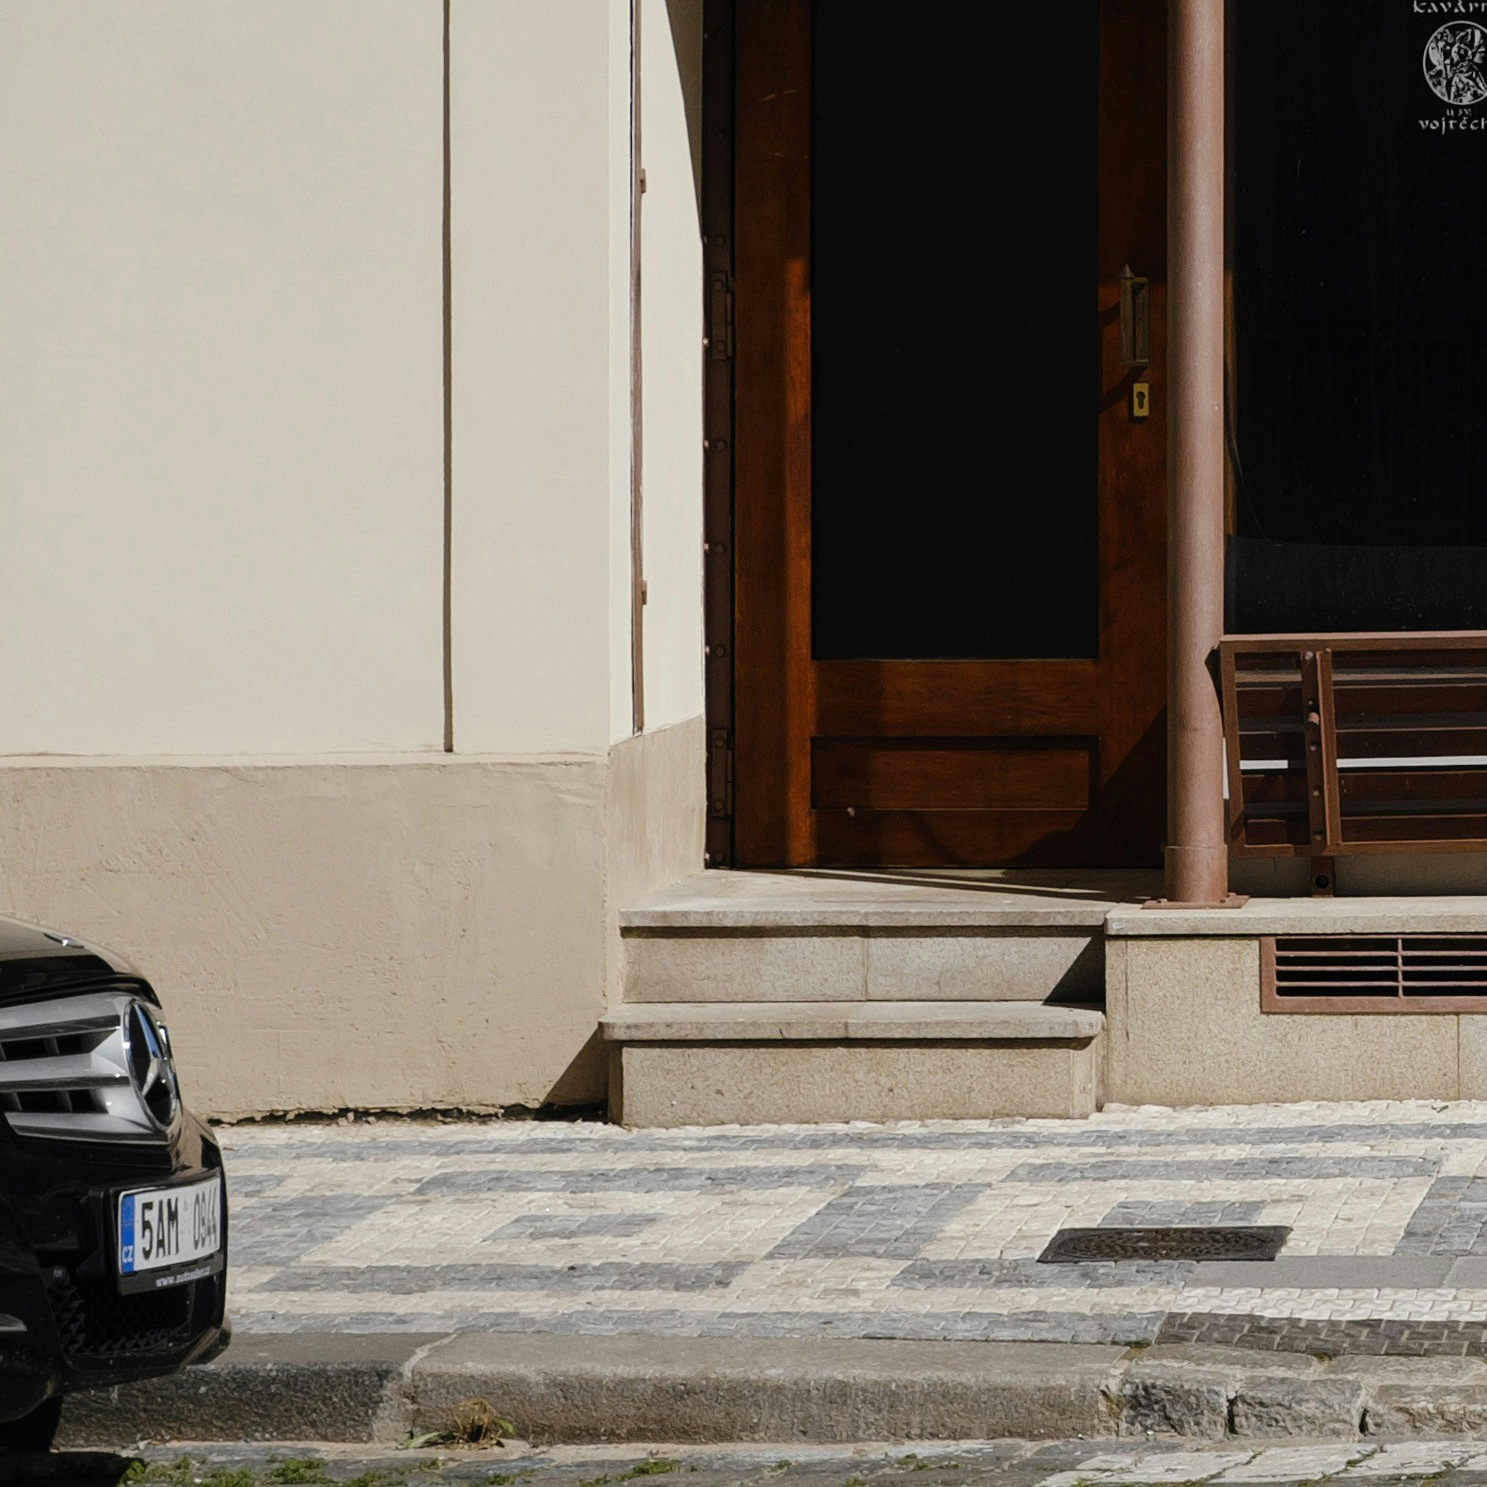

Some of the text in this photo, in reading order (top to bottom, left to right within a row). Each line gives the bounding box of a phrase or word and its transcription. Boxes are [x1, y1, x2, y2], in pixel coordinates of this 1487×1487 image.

[142, 1187, 217, 1260] 5AM 0944
[121, 1245, 134, 1264] CZ
